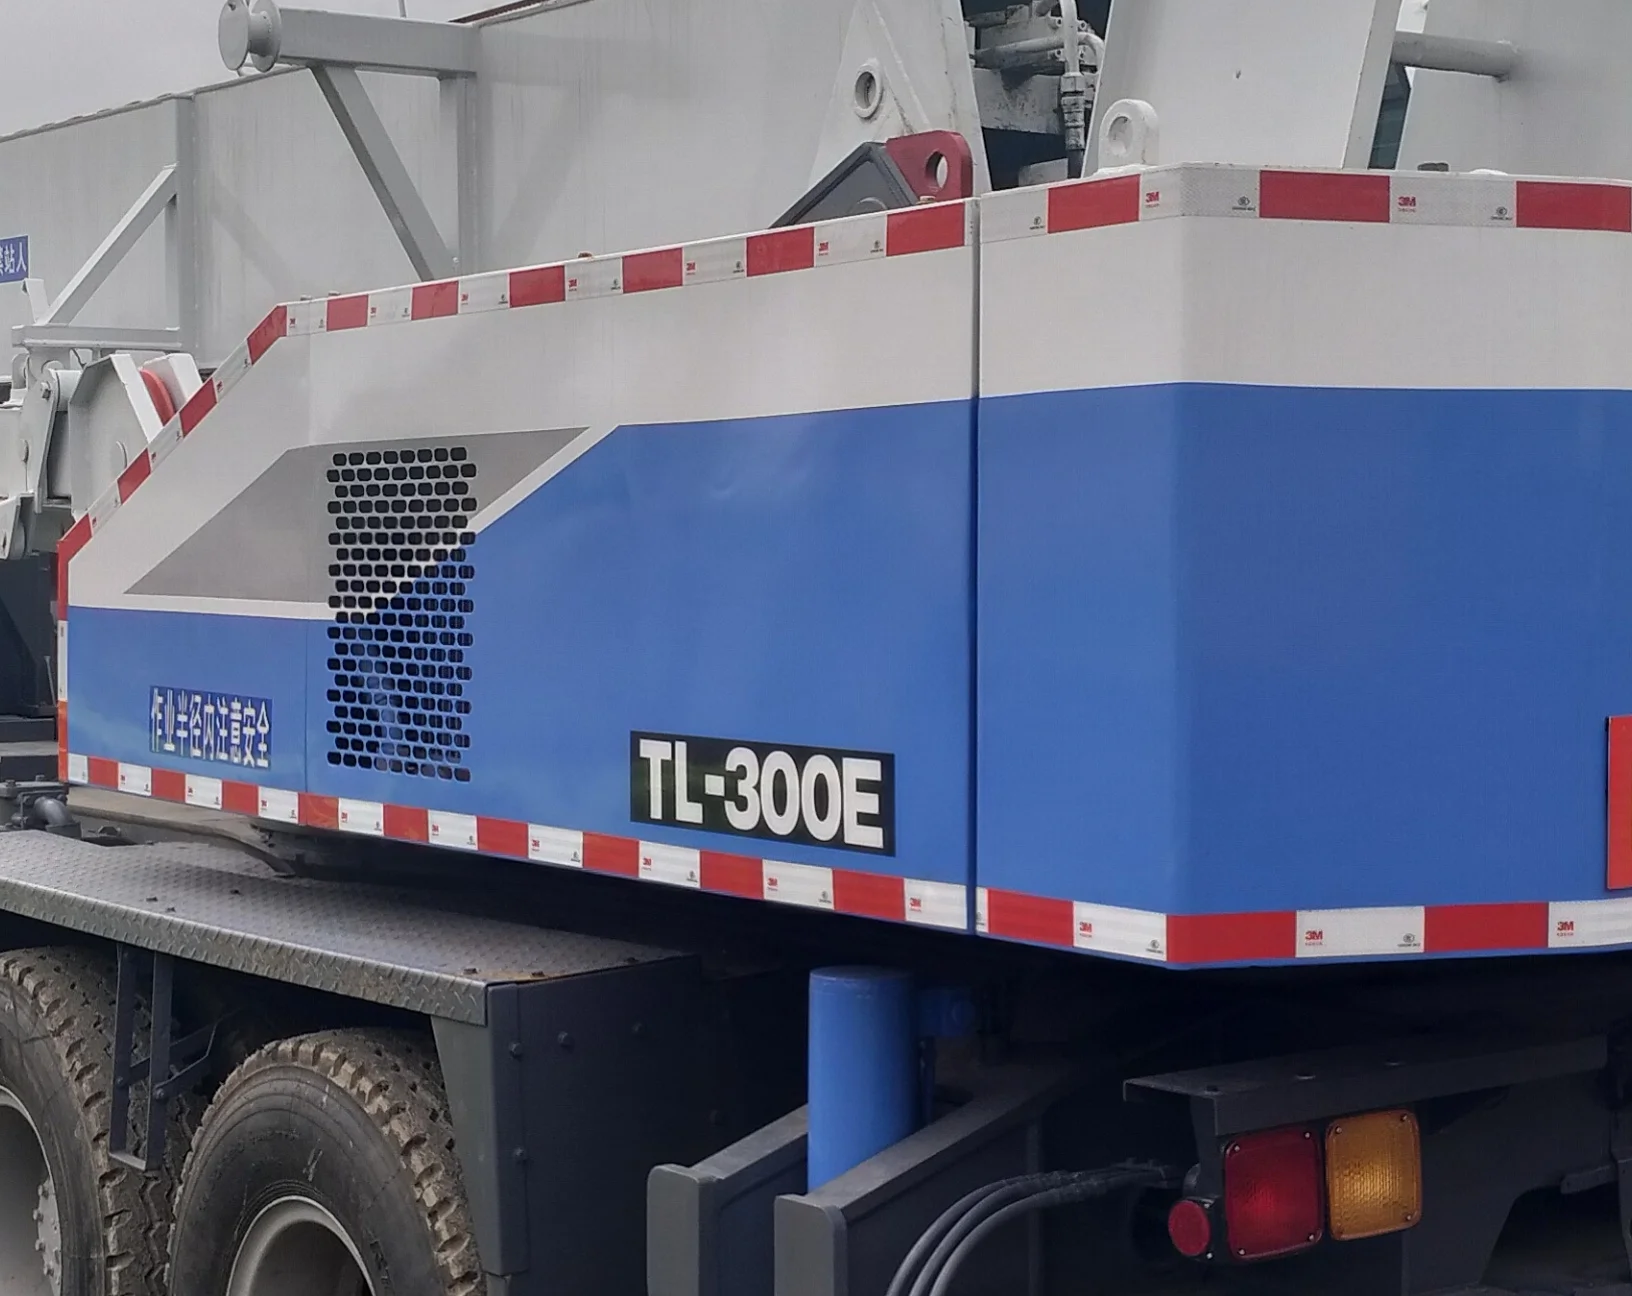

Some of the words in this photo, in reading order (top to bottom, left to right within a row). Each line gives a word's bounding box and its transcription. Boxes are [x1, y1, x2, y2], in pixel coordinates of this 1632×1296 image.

[1398, 196, 1416, 207] 3M
[151, 687, 269, 768] 作业半径内注意安全
[639, 738, 884, 849] TL-300E
[1558, 920, 1574, 931] 3M
[1305, 929, 1323, 940] 3M
